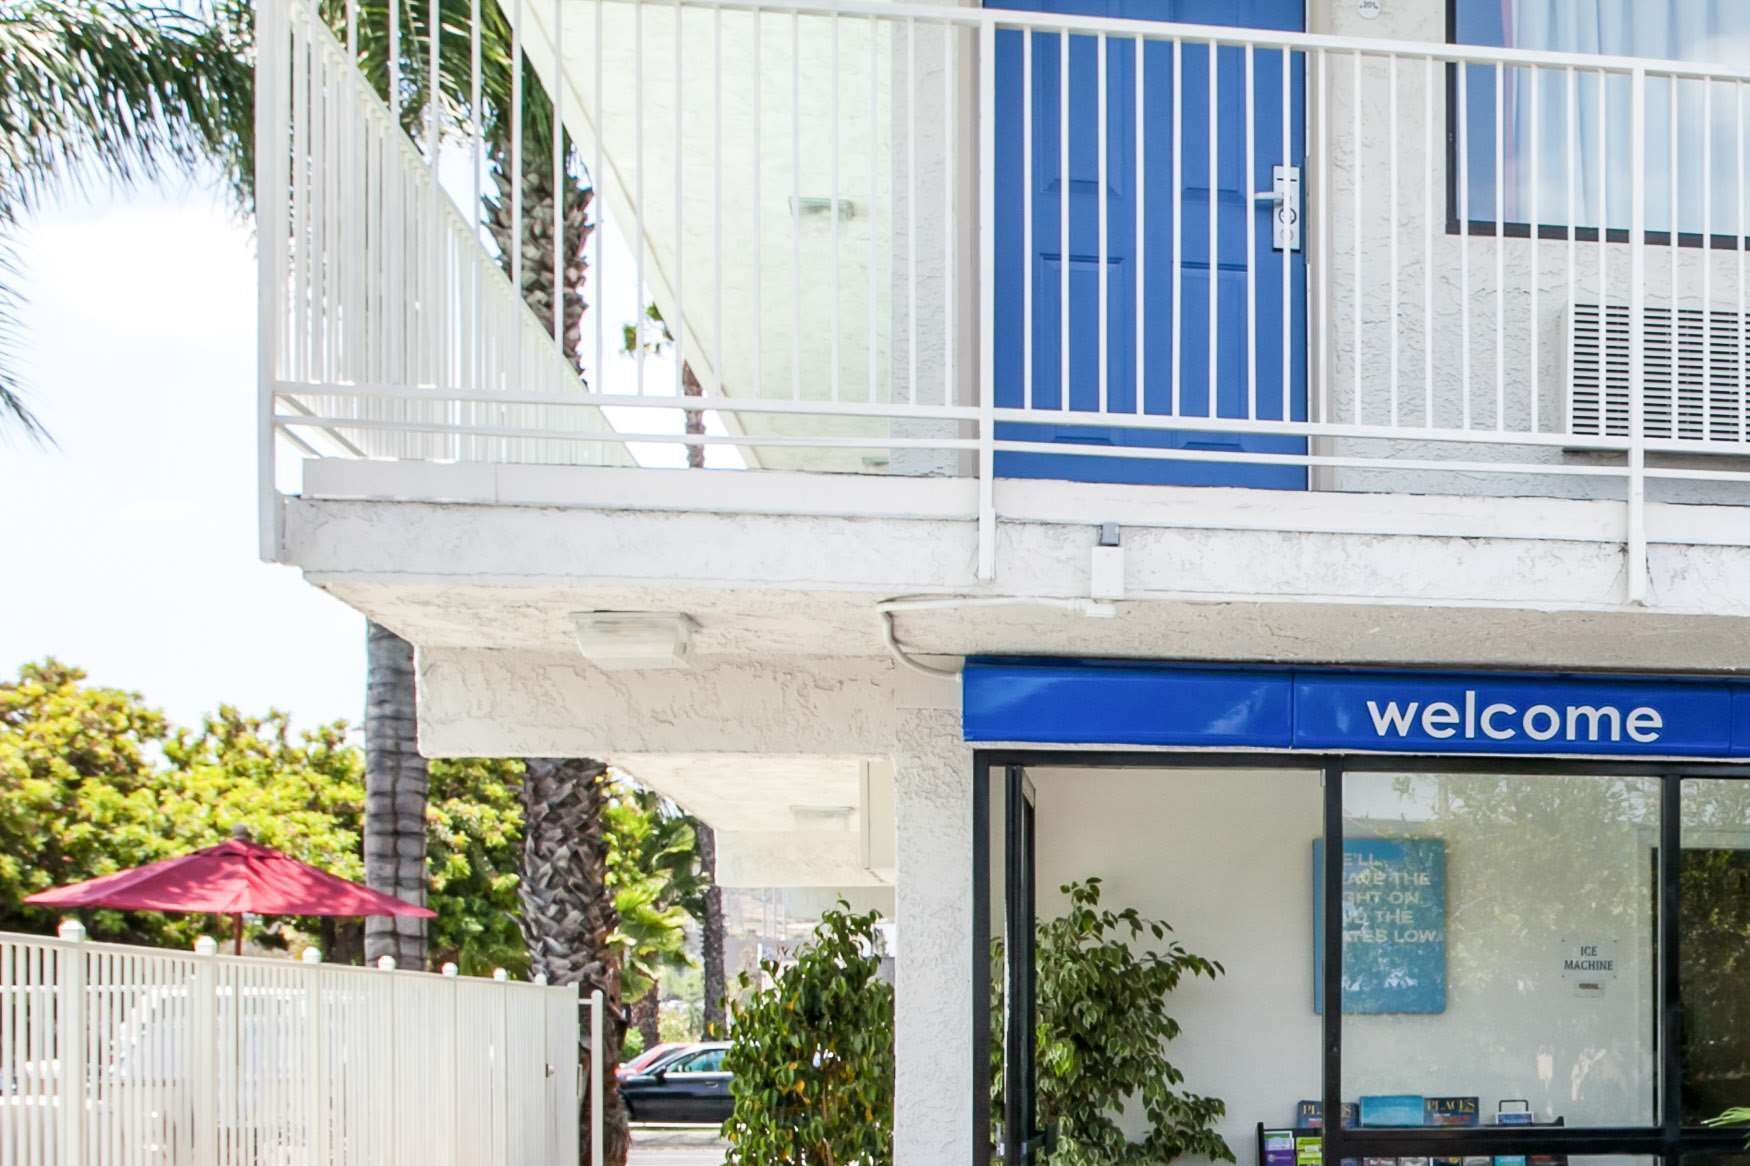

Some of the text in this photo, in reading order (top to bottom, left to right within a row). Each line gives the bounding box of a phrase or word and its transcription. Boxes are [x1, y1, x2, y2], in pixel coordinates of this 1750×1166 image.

[1366, 690, 1664, 743] welcome
[1580, 945, 1598, 957] ICE
[1563, 959, 1614, 971] MACHINE
